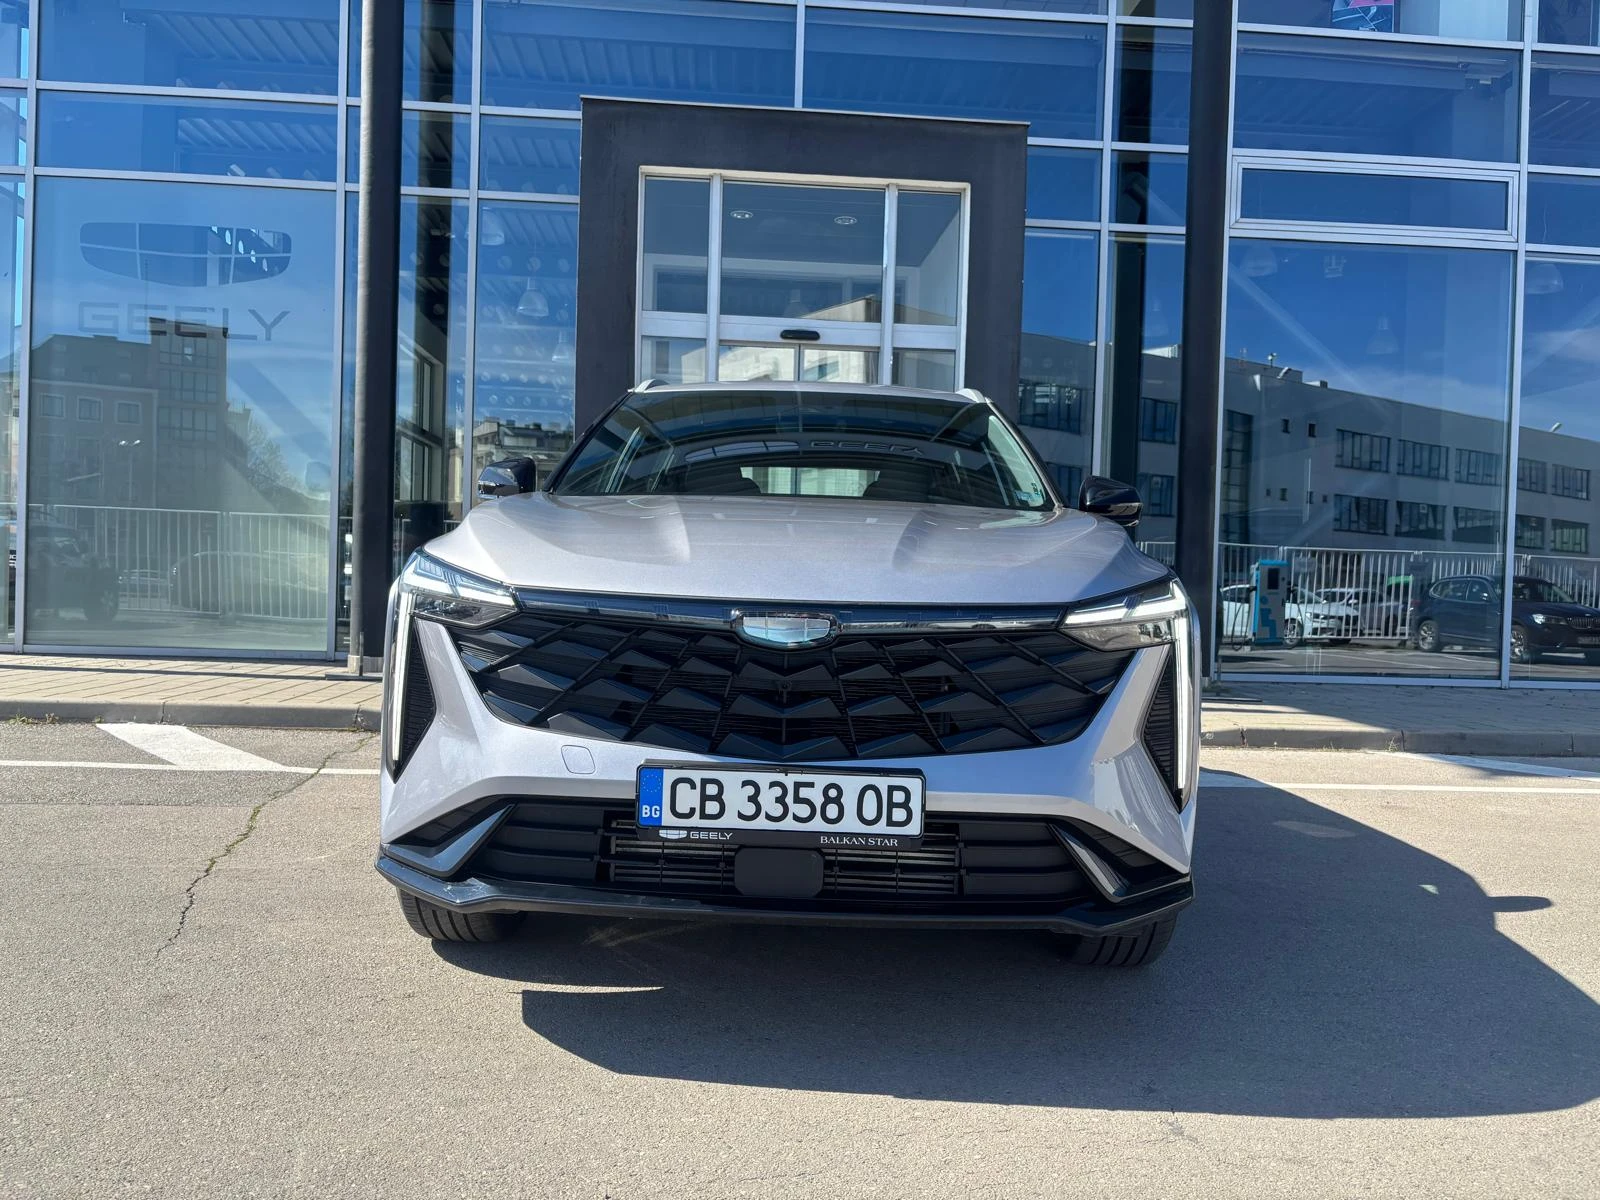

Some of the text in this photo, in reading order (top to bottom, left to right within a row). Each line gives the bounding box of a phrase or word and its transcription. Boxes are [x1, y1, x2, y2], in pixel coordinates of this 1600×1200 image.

[79, 302, 291, 341] GEELY
[669, 777, 914, 828] CB 3358 OB
[642, 805, 660, 818] BG
[690, 831, 733, 840] GEELY
[820, 836, 898, 847] BALKAN STAR
